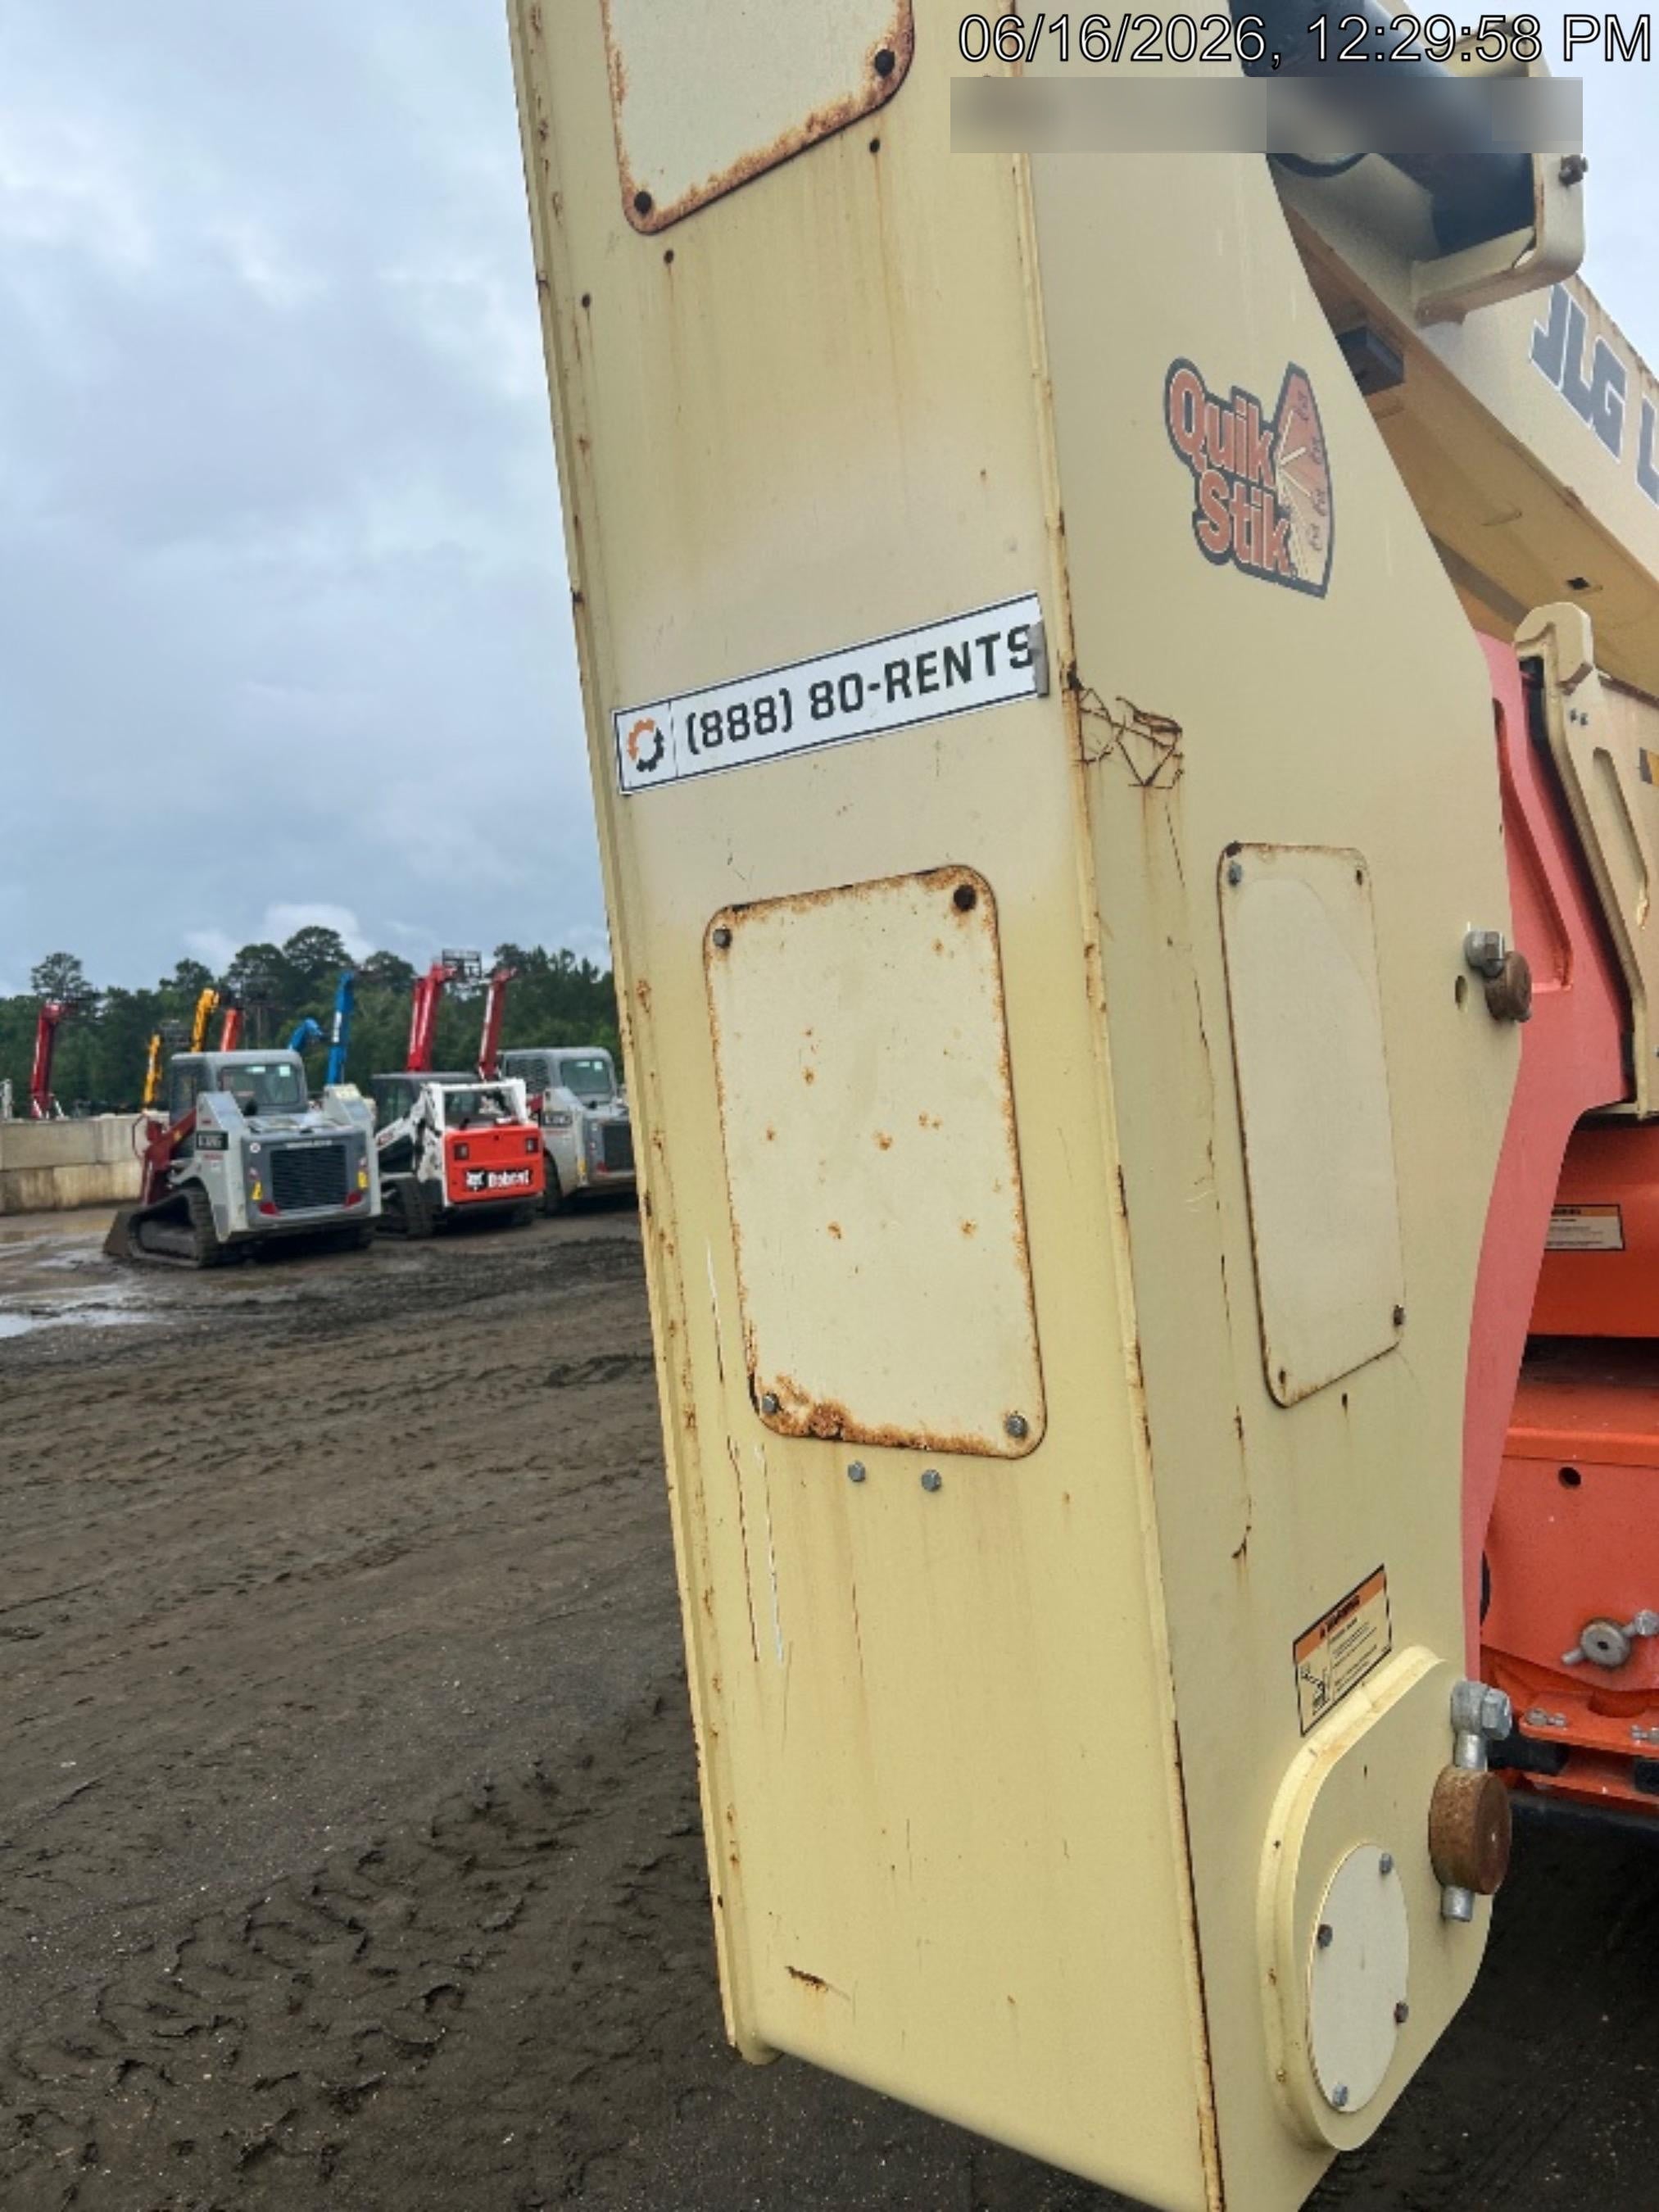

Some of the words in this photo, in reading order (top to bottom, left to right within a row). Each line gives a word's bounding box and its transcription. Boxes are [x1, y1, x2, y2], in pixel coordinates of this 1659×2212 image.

[1168, 367, 1277, 490] Quik
[1530, 282, 1627, 464] JLG
[1197, 469, 1290, 574] Stik
[687, 687, 792, 755] (888)
[808, 623, 1033, 723] 80-RENTS
